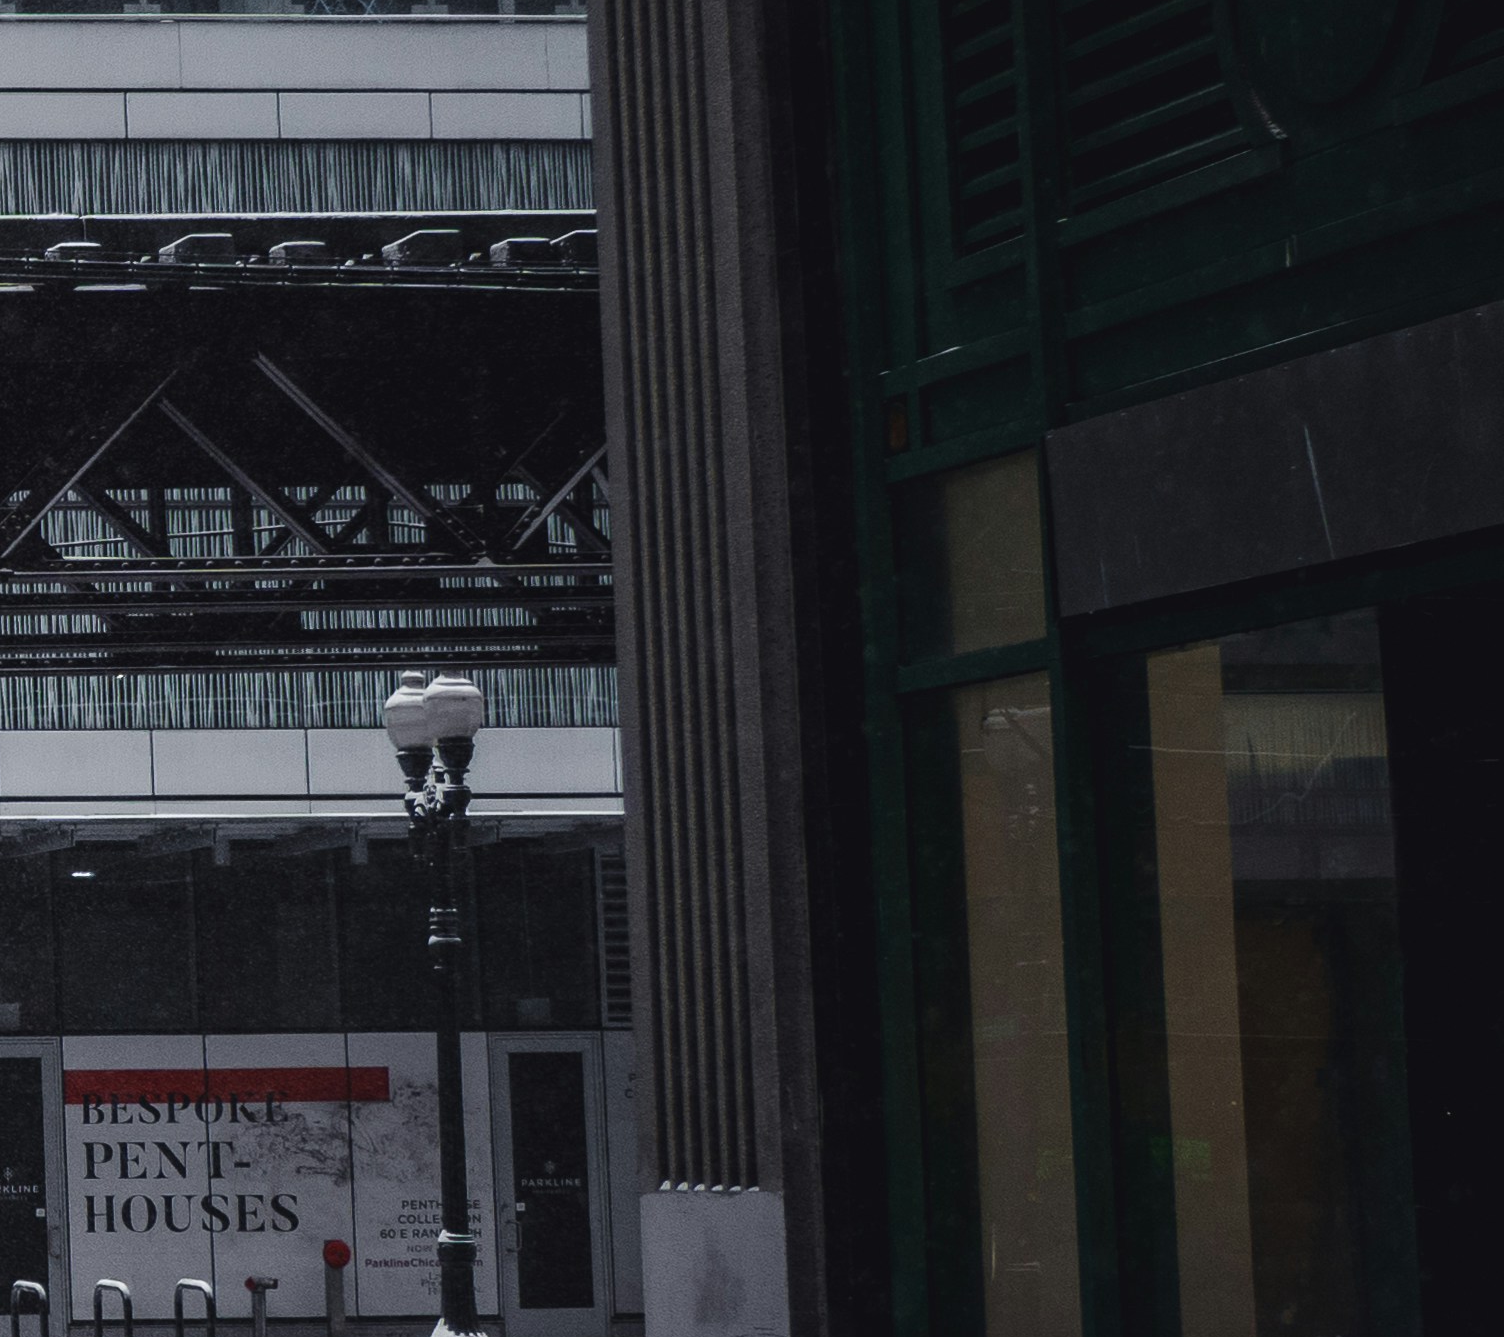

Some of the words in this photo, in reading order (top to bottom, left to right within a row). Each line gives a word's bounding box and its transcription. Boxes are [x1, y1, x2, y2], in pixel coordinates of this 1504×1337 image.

[81, 1092, 288, 1124] BESPOKE
[82, 1141, 251, 1179] PENT-
[521, 1178, 582, 1187] PARKLINE
[84, 1194, 300, 1233] HOUSES
[379, 1228, 397, 1239] 60
[400, 1228, 408, 1239] E
